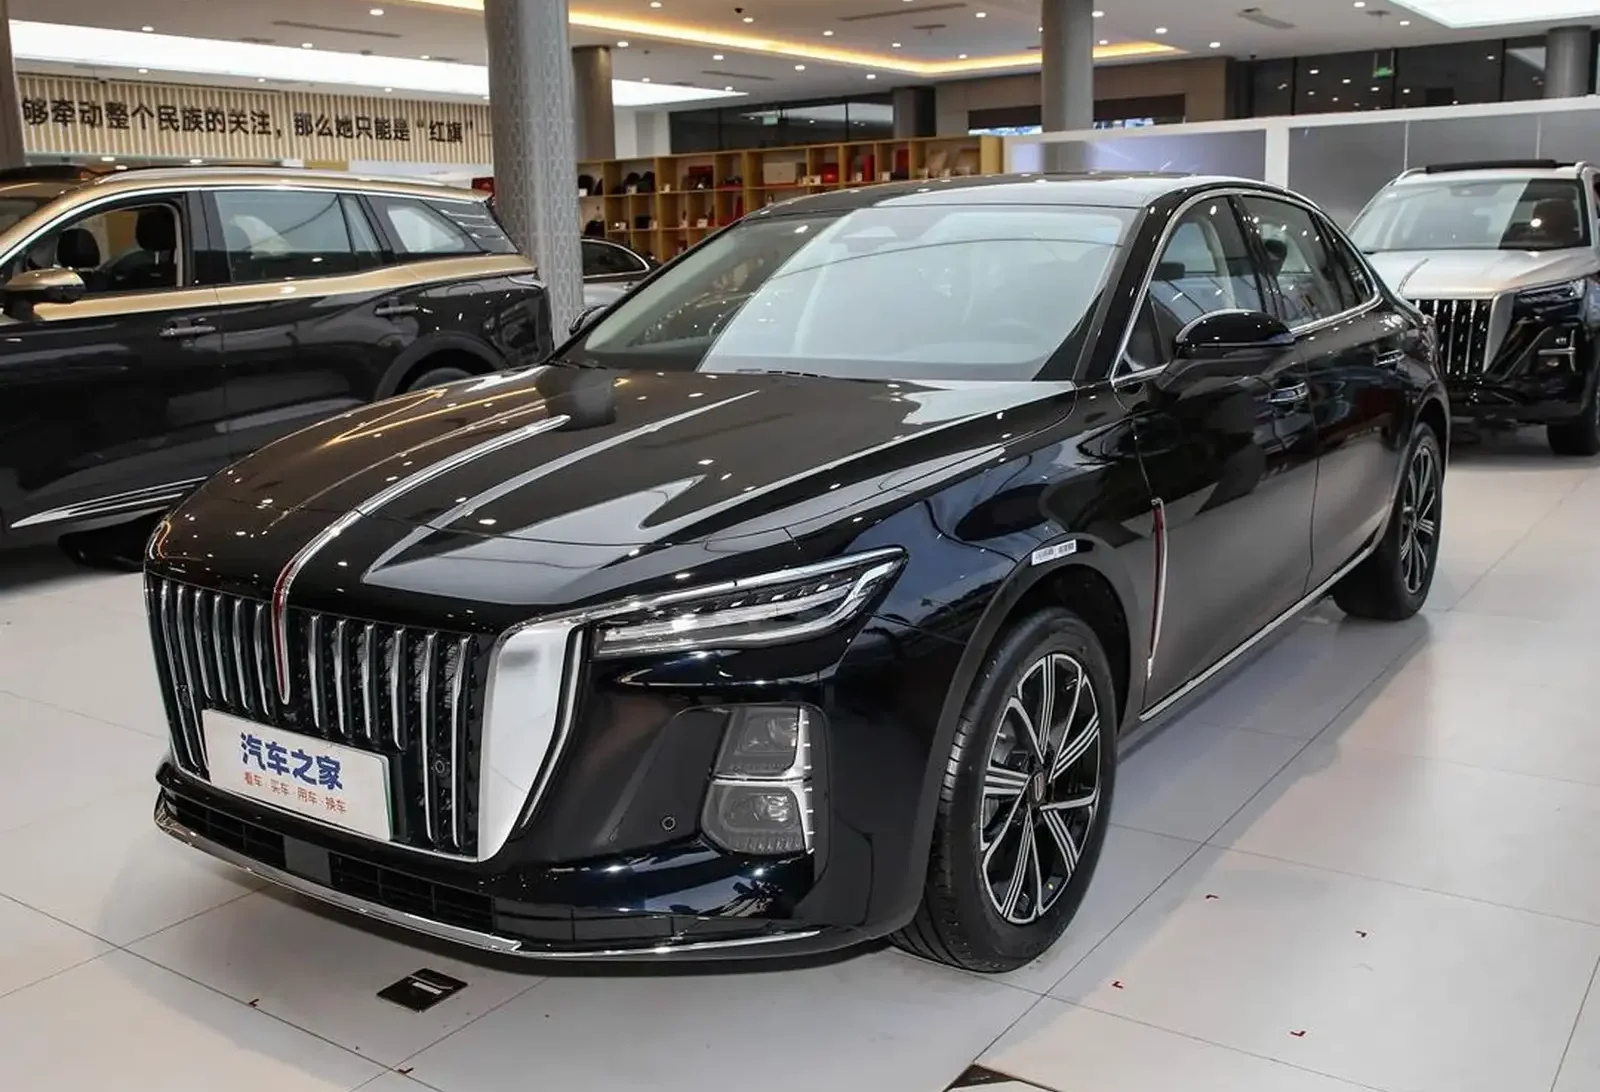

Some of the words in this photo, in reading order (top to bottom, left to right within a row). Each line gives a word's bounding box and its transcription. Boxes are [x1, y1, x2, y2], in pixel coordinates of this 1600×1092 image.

[240, 732, 343, 790] 汽车之家
[297, 787, 318, 804] 用车
